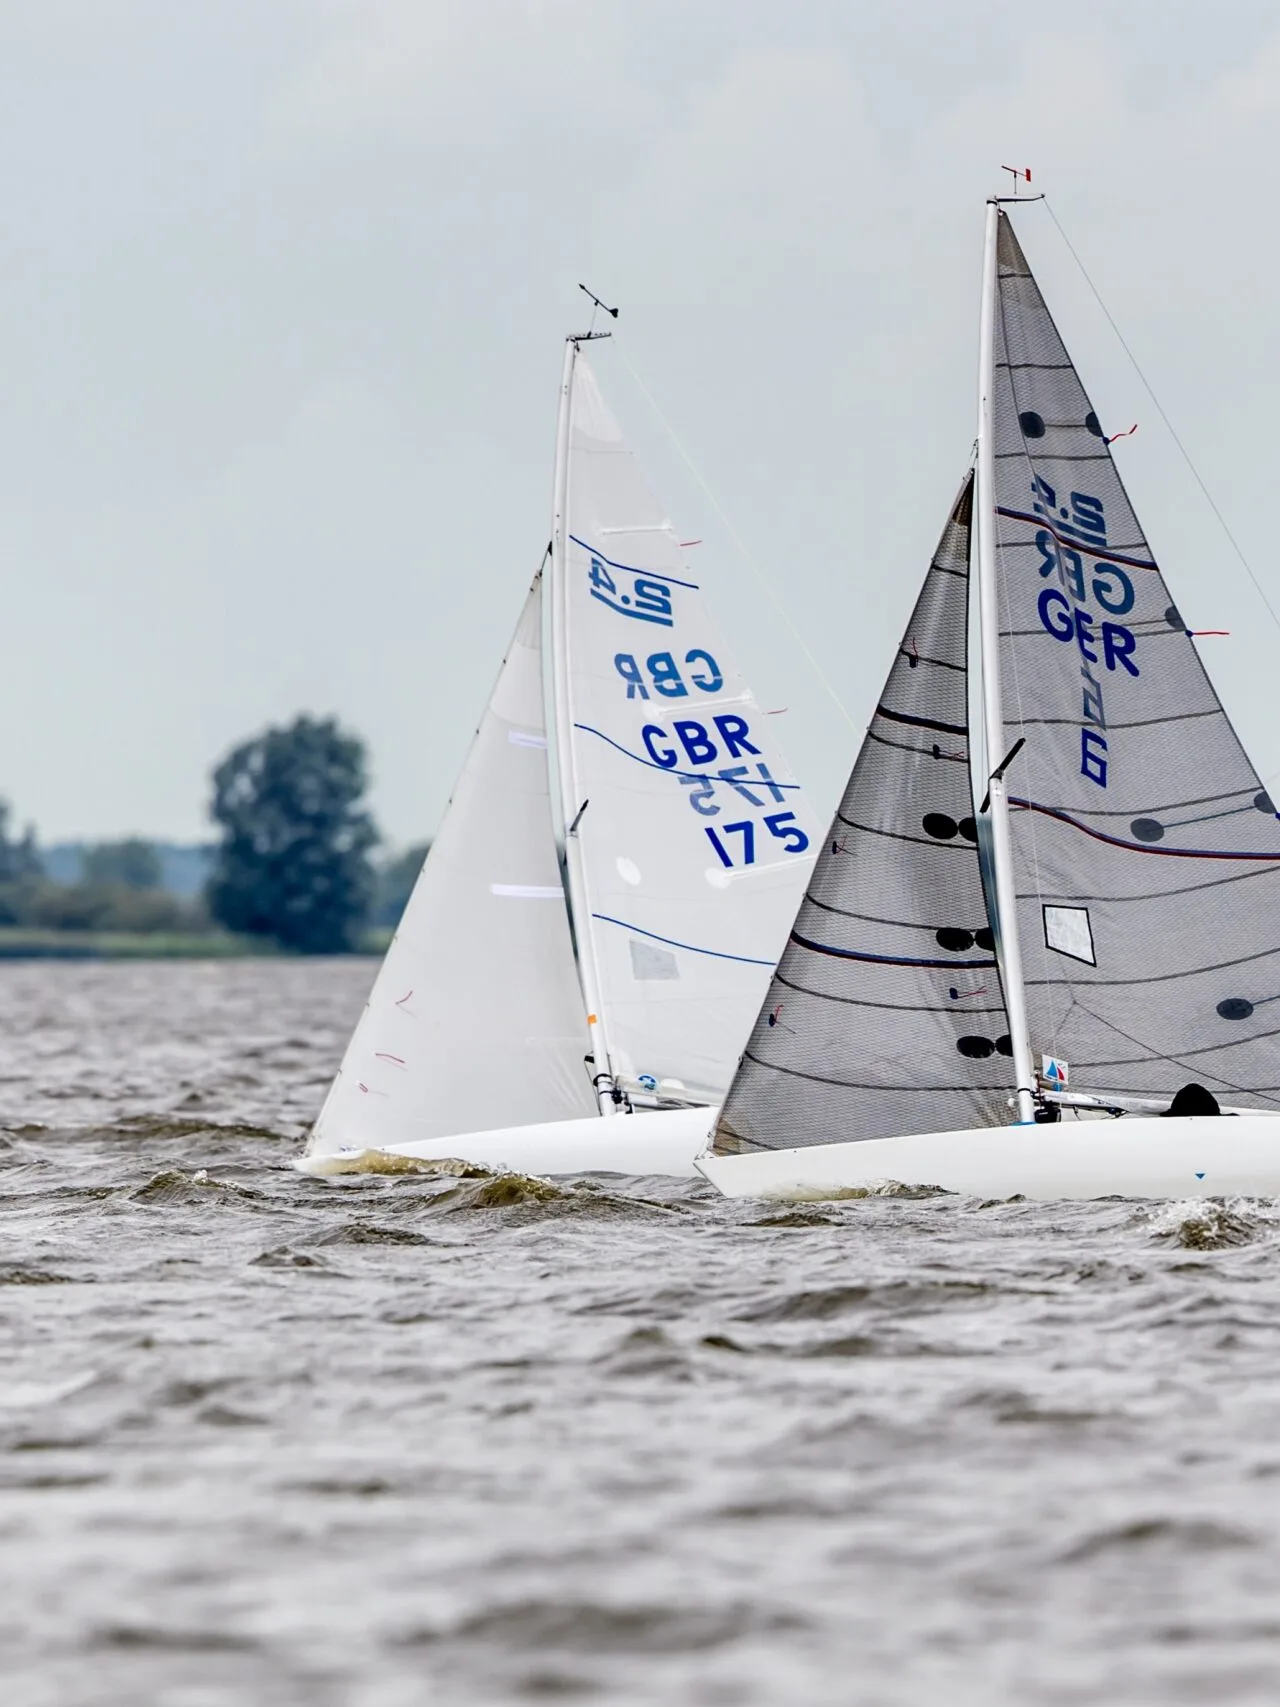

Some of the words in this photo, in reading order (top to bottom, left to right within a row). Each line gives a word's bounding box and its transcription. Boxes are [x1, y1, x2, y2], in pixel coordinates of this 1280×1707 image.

[1038, 588, 1140, 677] GER
[641, 714, 762, 769] GBR
[1081, 727, 1108, 789] 6
[704, 811, 809, 867] 175
